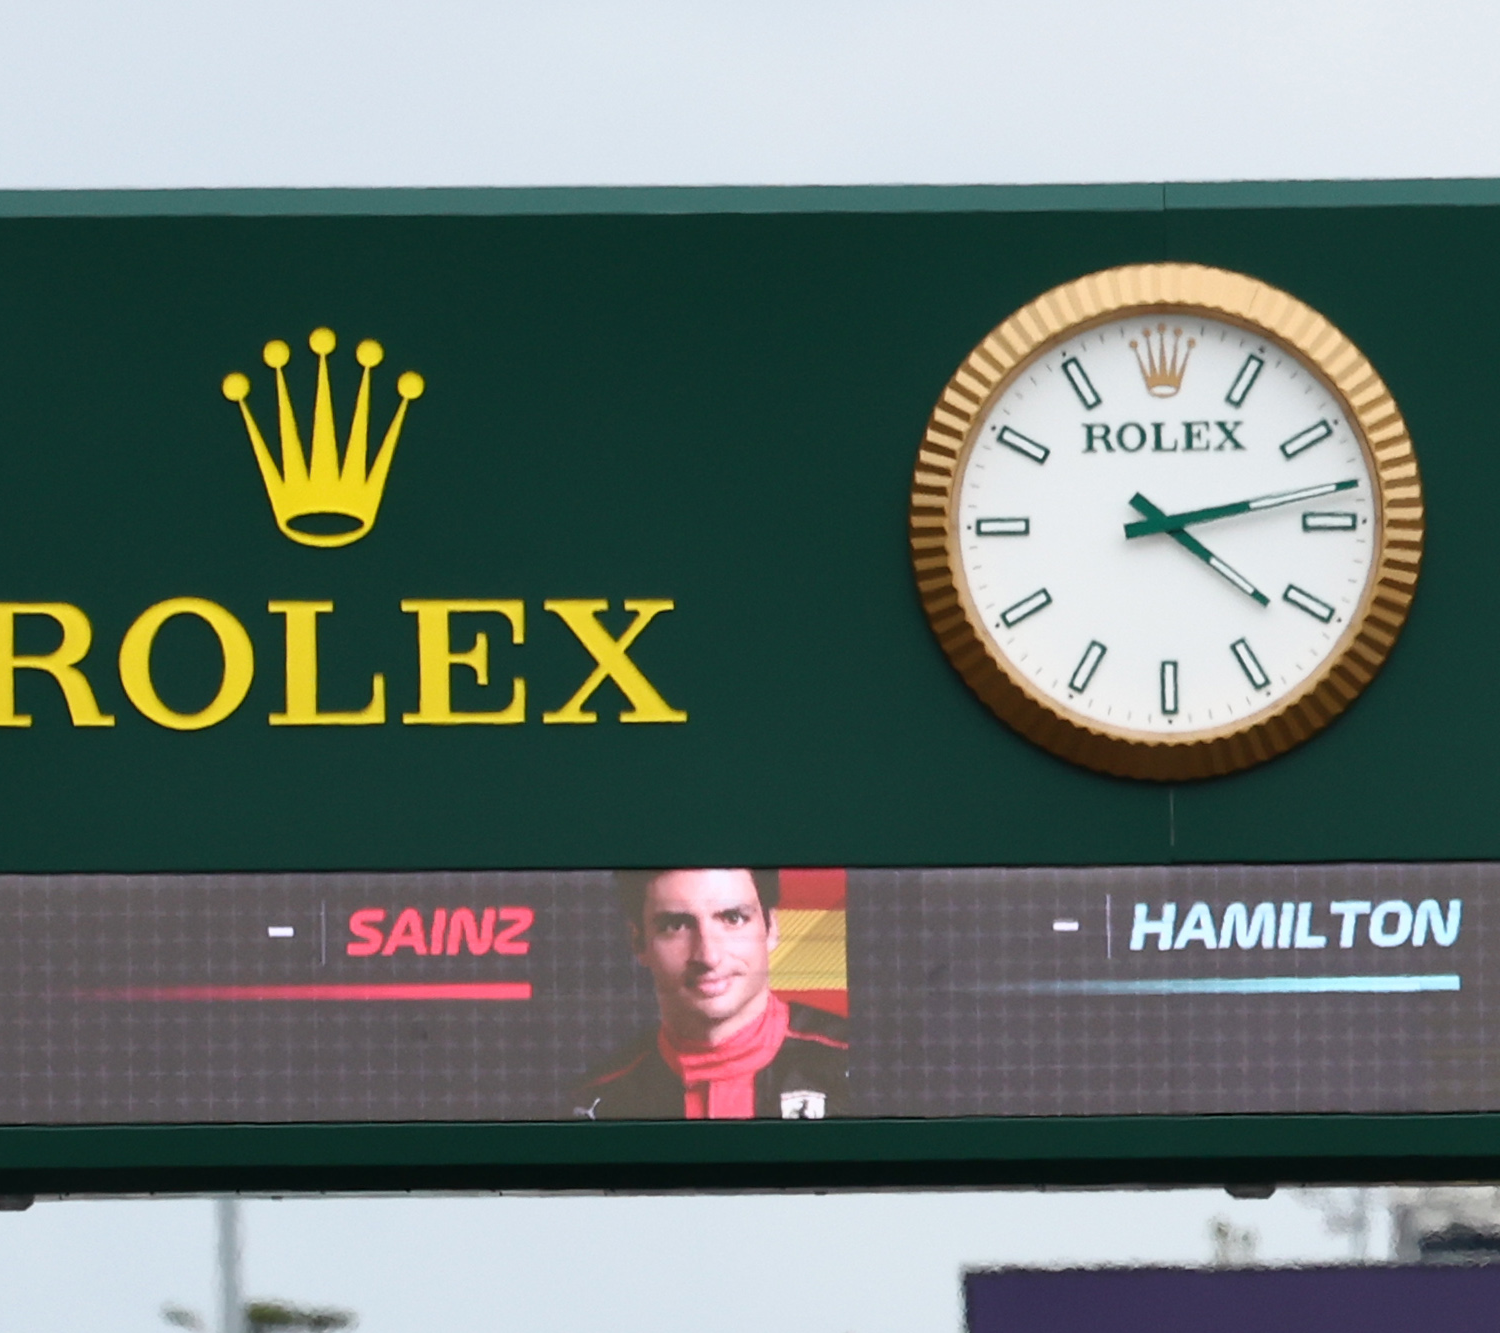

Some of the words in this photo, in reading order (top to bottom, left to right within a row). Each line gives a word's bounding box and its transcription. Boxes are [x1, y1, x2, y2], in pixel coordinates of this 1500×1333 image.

[1084, 420, 1244, 453] ROLEX
[346, 906, 534, 957] SAINZ
[1128, 897, 1462, 952] HAMILTON
